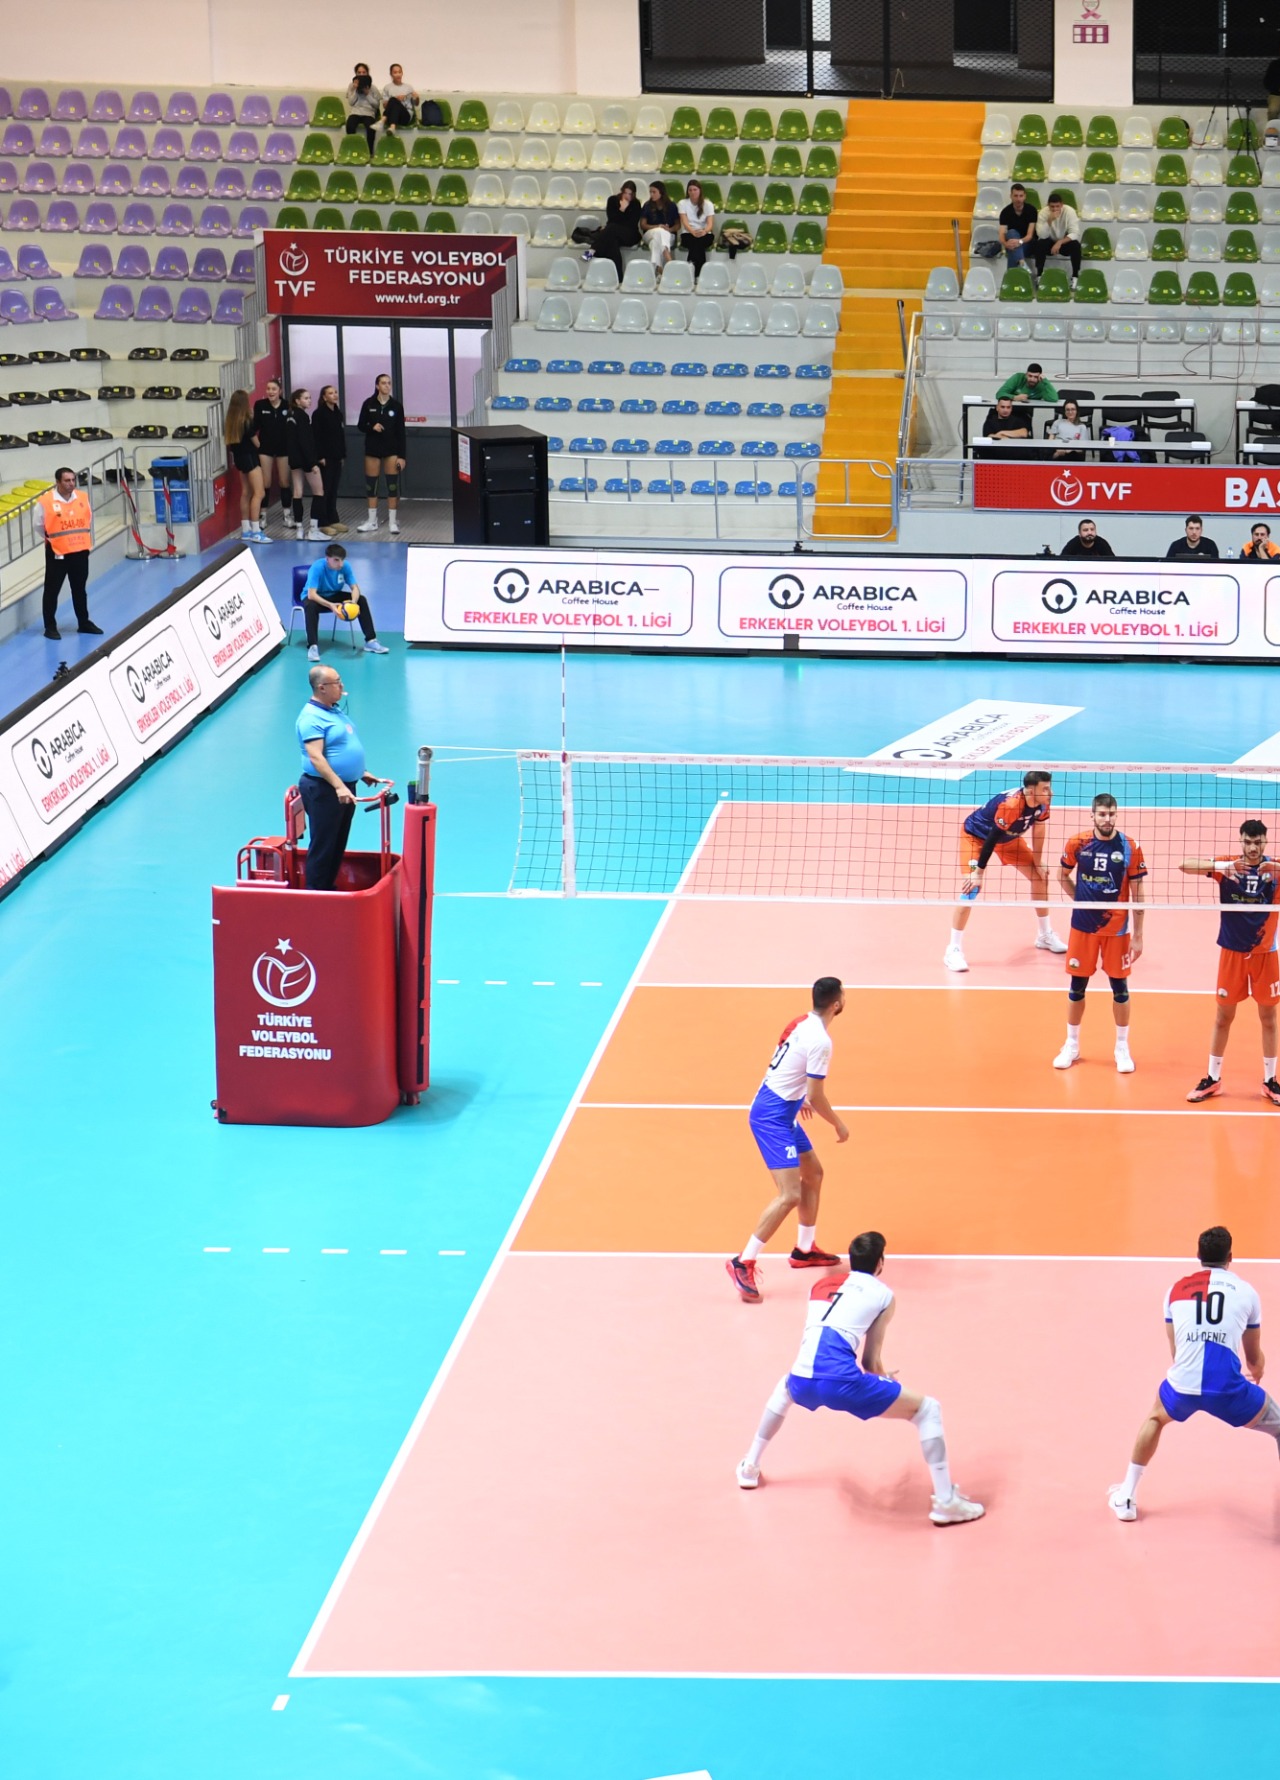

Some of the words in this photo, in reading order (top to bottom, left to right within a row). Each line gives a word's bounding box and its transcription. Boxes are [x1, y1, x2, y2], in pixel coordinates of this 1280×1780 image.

[324, 247, 404, 264] TÜRKİYE
[411, 252, 506, 266] VOLEYBOL
[350, 270, 485, 286] FEDERASYONU
[275, 281, 315, 297] TVF
[375, 294, 460, 306] www.tvf.org.tr
[1087, 482, 1131, 501] TVF
[538, 580, 643, 596] ARABICA
[813, 585, 917, 601] ARABICA
[1086, 590, 1190, 605] ARABICA
[218, 593, 244, 624] ARABICA
[464, 611, 537, 625] ERKEKLER
[542, 613, 622, 626] VOLEYBOL
[628, 615, 637, 626] 1.
[643, 612, 671, 627] LİGİ
[740, 617, 812, 630] ERKEKLER
[818, 619, 898, 632] VOLEYBOL
[902, 621, 911, 632] 1.
[917, 617, 945, 632] LİGİ
[1013, 622, 1086, 634] ERKEKLER
[1091, 623, 1170, 636] VOLEYBOL
[1175, 625, 1184, 636] 1.
[1190, 622, 1218, 637] LİGİ
[142, 651, 174, 685] ARABICA
[933, 713, 1008, 748] ARABICA
[50, 720, 86, 759] ARABICA
[41, 784, 69, 812] ERKEKLER
[66, 761, 96, 792] VOLEYBOL
[97, 744, 111, 766] LİGİ
[1093, 858, 1108, 871] 13
[1245, 881, 1258, 893] 17
[257, 1012, 312, 1027] TÜRKİYE
[252, 1030, 318, 1043] VOLEYBOL
[239, 1046, 331, 1060] FEDERASYONU
[785, 1146, 797, 1159] 20
[821, 1292, 844, 1322] 7
[1190, 1291, 1225, 1325] 10
[1186, 1329, 1199, 1342] ALİ
